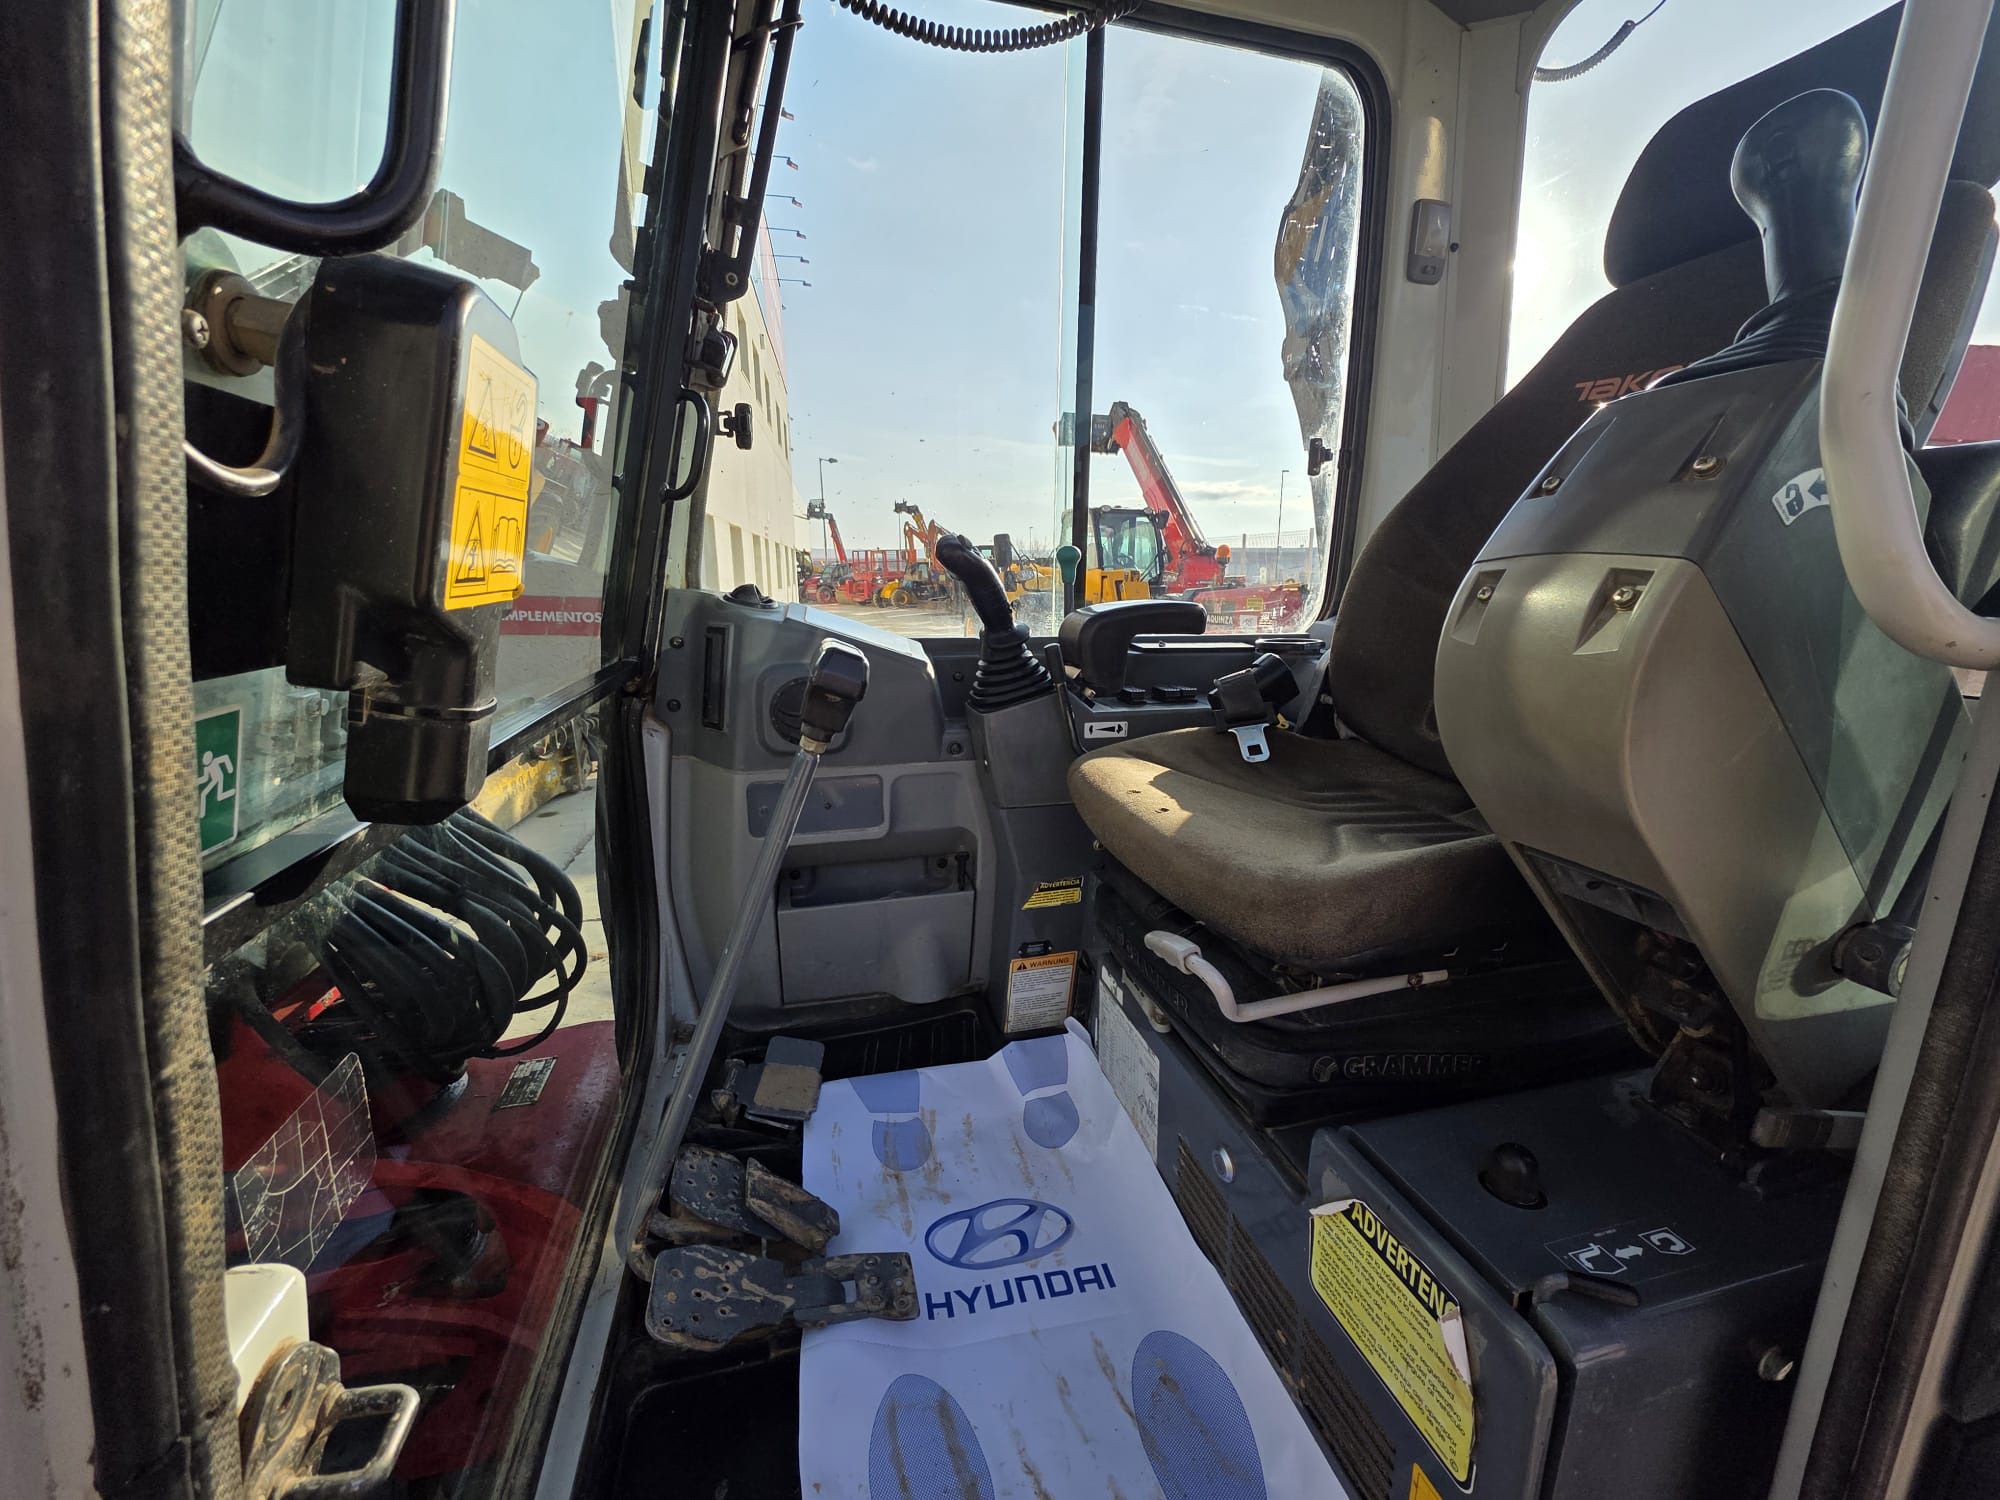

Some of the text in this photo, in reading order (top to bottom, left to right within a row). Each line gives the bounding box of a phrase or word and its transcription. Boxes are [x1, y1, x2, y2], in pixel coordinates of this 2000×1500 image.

[503, 608, 602, 624] MPLEMENTOS
[1206, 614, 1233, 625] AQUINZA
[1029, 957, 1070, 968] WARNUNG
[925, 1263, 1116, 1321] HYUNDAI
[1426, 1341, 1446, 1368] antes
